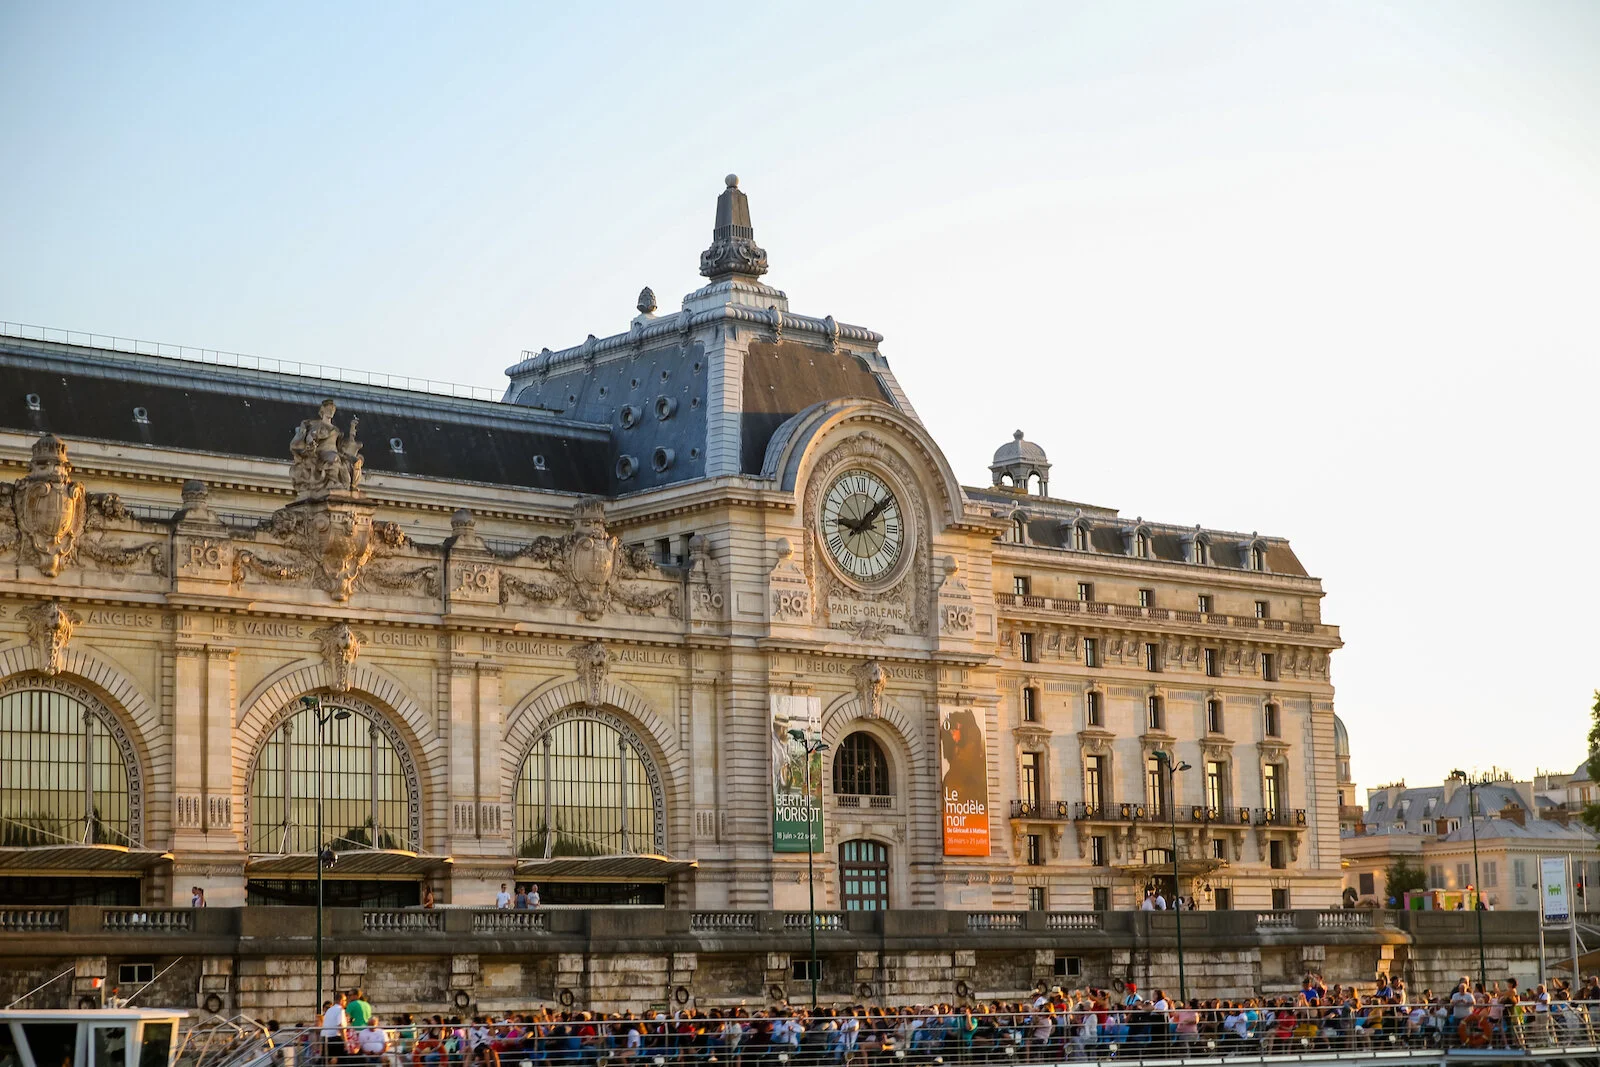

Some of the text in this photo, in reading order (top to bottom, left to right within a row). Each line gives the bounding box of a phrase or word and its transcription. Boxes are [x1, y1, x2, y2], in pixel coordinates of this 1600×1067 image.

[839, 479, 852, 497] XI
[855, 476, 866, 493] XII
[828, 494, 841, 509] X
[886, 524, 898, 535] III
[829, 534, 843, 556] VIII
[842, 551, 853, 570] VII
[860, 558, 868, 575] VI
[875, 556, 884, 571] V
[462, 570, 488, 588] PO
[700, 592, 723, 608] PO
[780, 595, 803, 611] PO
[87, 609, 153, 627] ANGERS
[831, 603, 903, 620] PARIS-ORLEANS
[947, 610, 968, 626] PO
[243, 621, 303, 638] VANNES
[372, 631, 431, 647] LORIENT
[506, 641, 564, 657] QUIMPER
[619, 649, 676, 665] AURILLAC
[813, 660, 846, 674] BLOIS
[890, 667, 924, 680] TOURS
[775, 793, 813, 807] BERTHE
[945, 786, 958, 801] Le
[775, 806, 821, 823] MORISOT
[946, 799, 985, 815] modèle
[946, 815, 967, 827] noir
[797, 831, 804, 840] 22
